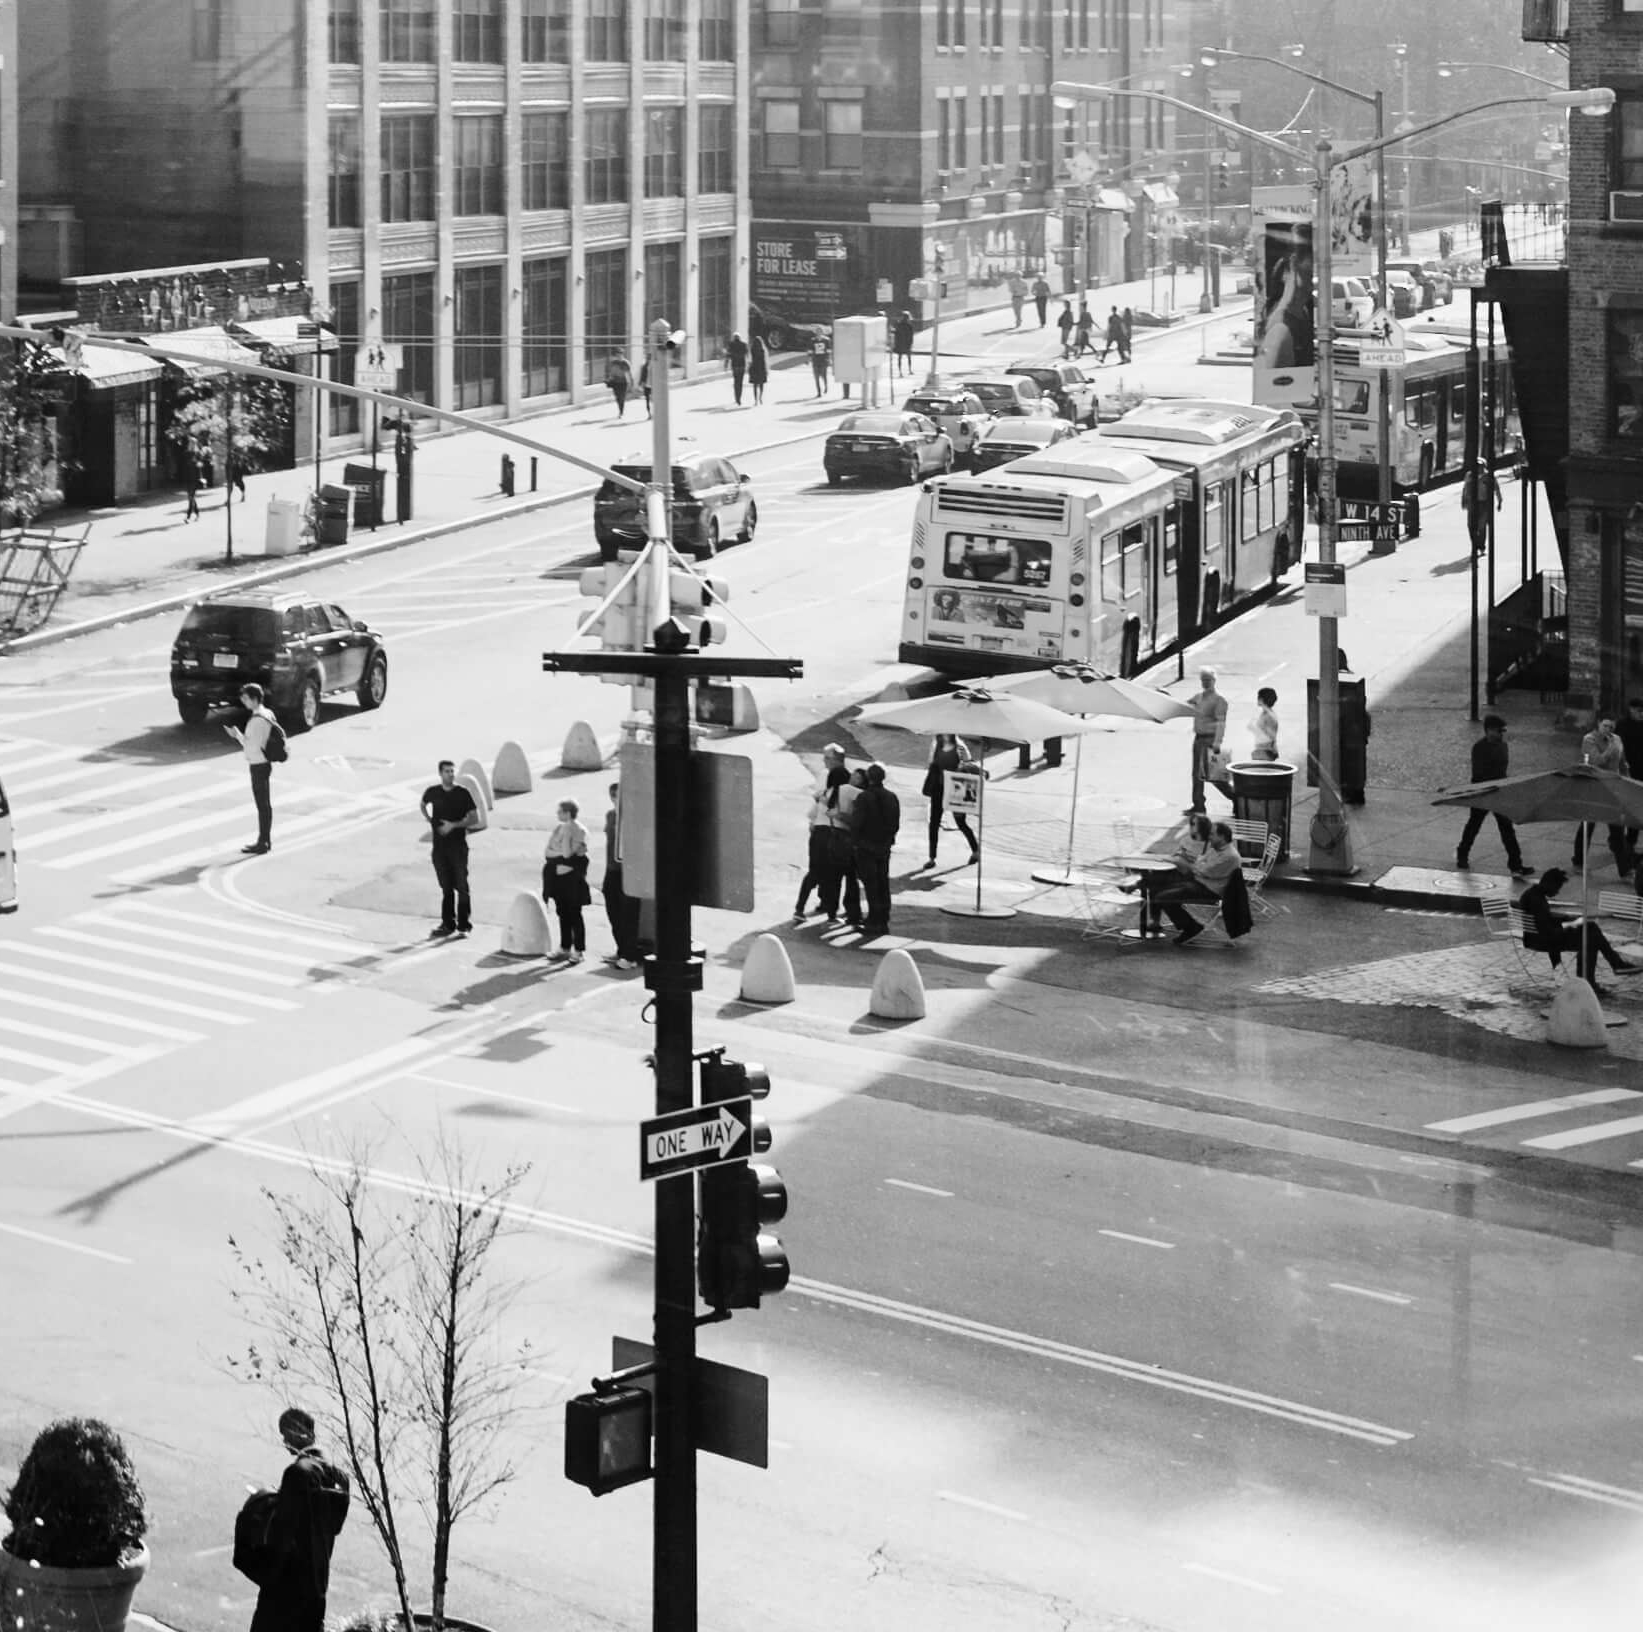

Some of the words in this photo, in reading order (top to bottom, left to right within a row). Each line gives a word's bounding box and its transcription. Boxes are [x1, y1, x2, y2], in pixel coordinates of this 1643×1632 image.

[756, 241, 793, 259] STORE
[756, 258, 780, 274] FOR
[782, 259, 818, 276] LEASE
[1365, 354, 1402, 363] AHEAD
[1345, 503, 1358, 519] W
[1364, 504, 1381, 521] 14
[1387, 506, 1407, 523] ST
[1341, 525, 1371, 541] NINTH
[1376, 524, 1396, 540] AVE
[656, 1129, 688, 1159] ONE
[701, 1119, 735, 1148] WAY
